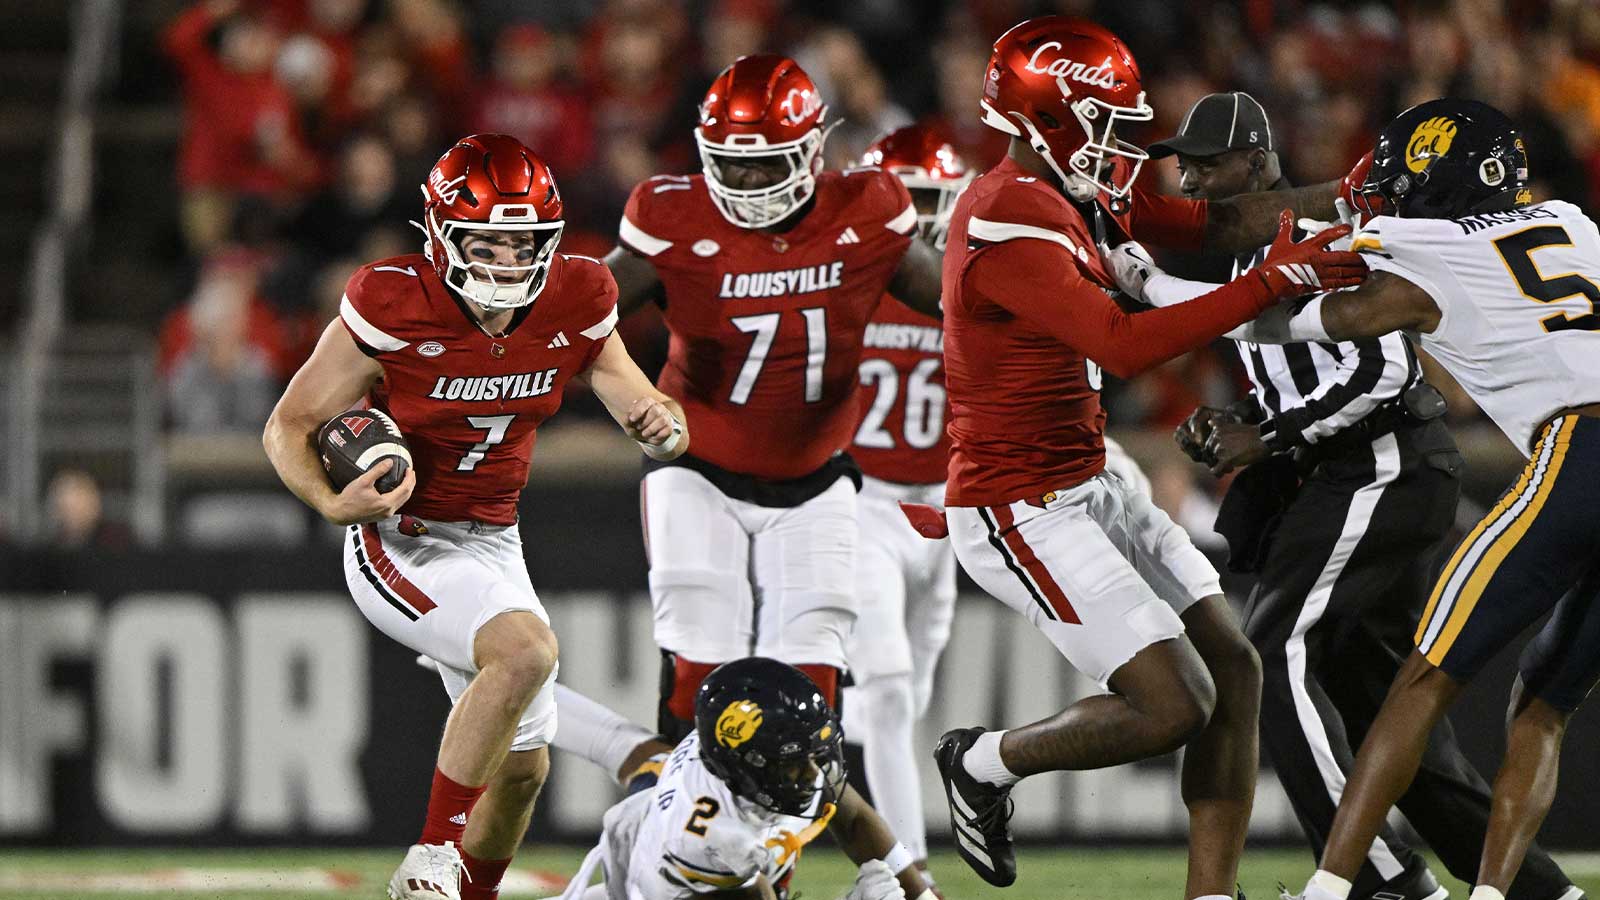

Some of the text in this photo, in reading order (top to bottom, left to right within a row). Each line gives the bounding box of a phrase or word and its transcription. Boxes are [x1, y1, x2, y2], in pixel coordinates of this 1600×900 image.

[1024, 41, 1115, 90] Cards
[1249, 131, 1258, 143] S
[1410, 134, 1440, 163] Cal
[718, 261, 844, 299] LOUISVILLE
[1491, 225, 1600, 334] 5
[421, 345, 441, 353] ACC
[730, 307, 828, 405] 71
[428, 367, 558, 401] LOUISVILLE
[853, 358, 947, 449] 26
[457, 413, 517, 471] 7
[0, 591, 374, 836] FOR
[719, 715, 746, 740] Cal
[683, 794, 720, 838] 2
